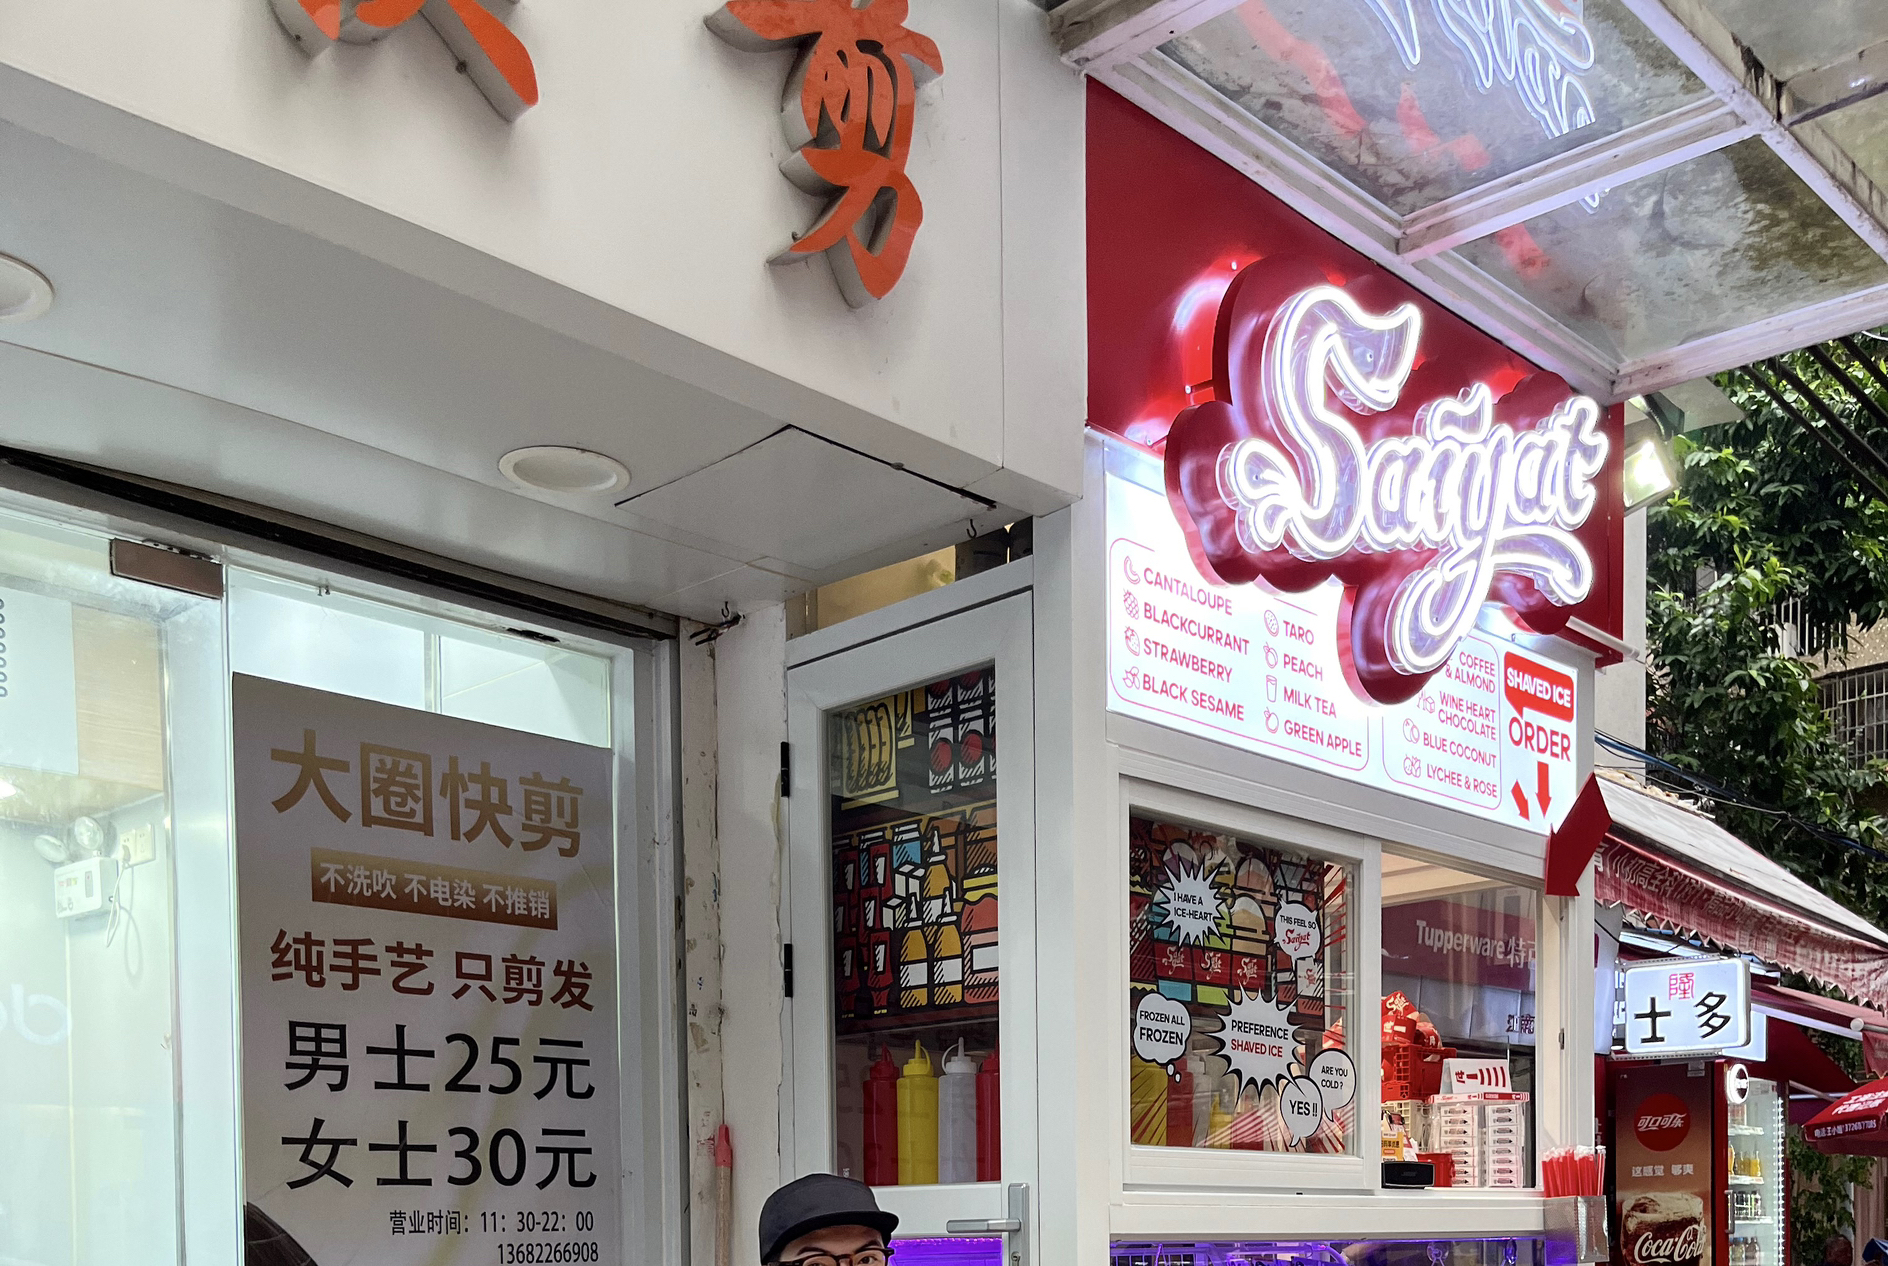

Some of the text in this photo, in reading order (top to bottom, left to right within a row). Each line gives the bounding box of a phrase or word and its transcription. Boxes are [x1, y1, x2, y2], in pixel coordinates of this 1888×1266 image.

[1143, 567, 1233, 616] CANTALOUPE
[1143, 601, 1250, 656] BLACKCURRANT
[1283, 619, 1315, 646] TARO
[1143, 637, 1233, 684] STRAWBERRY
[1283, 653, 1323, 682] PEACH
[1459, 651, 1496, 677] COFFEE
[1142, 673, 1245, 722] BLACK SESAME
[1454, 667, 1496, 694] ALMOND
[1506, 667, 1572, 709] SHAVED ICE
[1283, 685, 1337, 719] MILK TEA
[1439, 690, 1496, 724] WINE HEART
[1283, 719, 1362, 758] GREEN APPLE
[1438, 708, 1497, 742] CHOCOLATE
[1508, 716, 1572, 763] ORDER
[1423, 731, 1497, 769] BLUE COCONUT
[269, 728, 585, 860] 大圈快剪
[1426, 763, 1462, 790] LYCHEE
[1473, 778, 1498, 799] ROSE
[319, 861, 551, 922] 不洗吹 不电染 不推销
[1178, 893, 1197, 905] HAVE
[1173, 906, 1214, 923] ICE-HEART
[1280, 914, 1317, 930] THIS FEEL SO
[1416, 919, 1505, 960] Tupperware
[269, 928, 595, 1012] 纯手艺 只剪发
[1139, 1010, 1186, 1026] FROZEN ALL
[1231, 1019, 1289, 1041] PREFERENCE
[1634, 991, 1732, 1044] 士多
[1139, 1027, 1184, 1047] FROZEN
[1230, 1039, 1284, 1058] SHAVED ICE
[283, 1019, 596, 1100] 男士25元
[1321, 1065, 1348, 1078] ARE YOU
[1320, 1078, 1338, 1089] COLD
[1289, 1099, 1310, 1117] YES
[1637, 1112, 1688, 1132] 可口可乐
[281, 1117, 598, 1191] 女士30元
[1632, 1163, 1694, 1178] 这感觉 够爽
[496, 1240, 599, 1266] 13682266908
